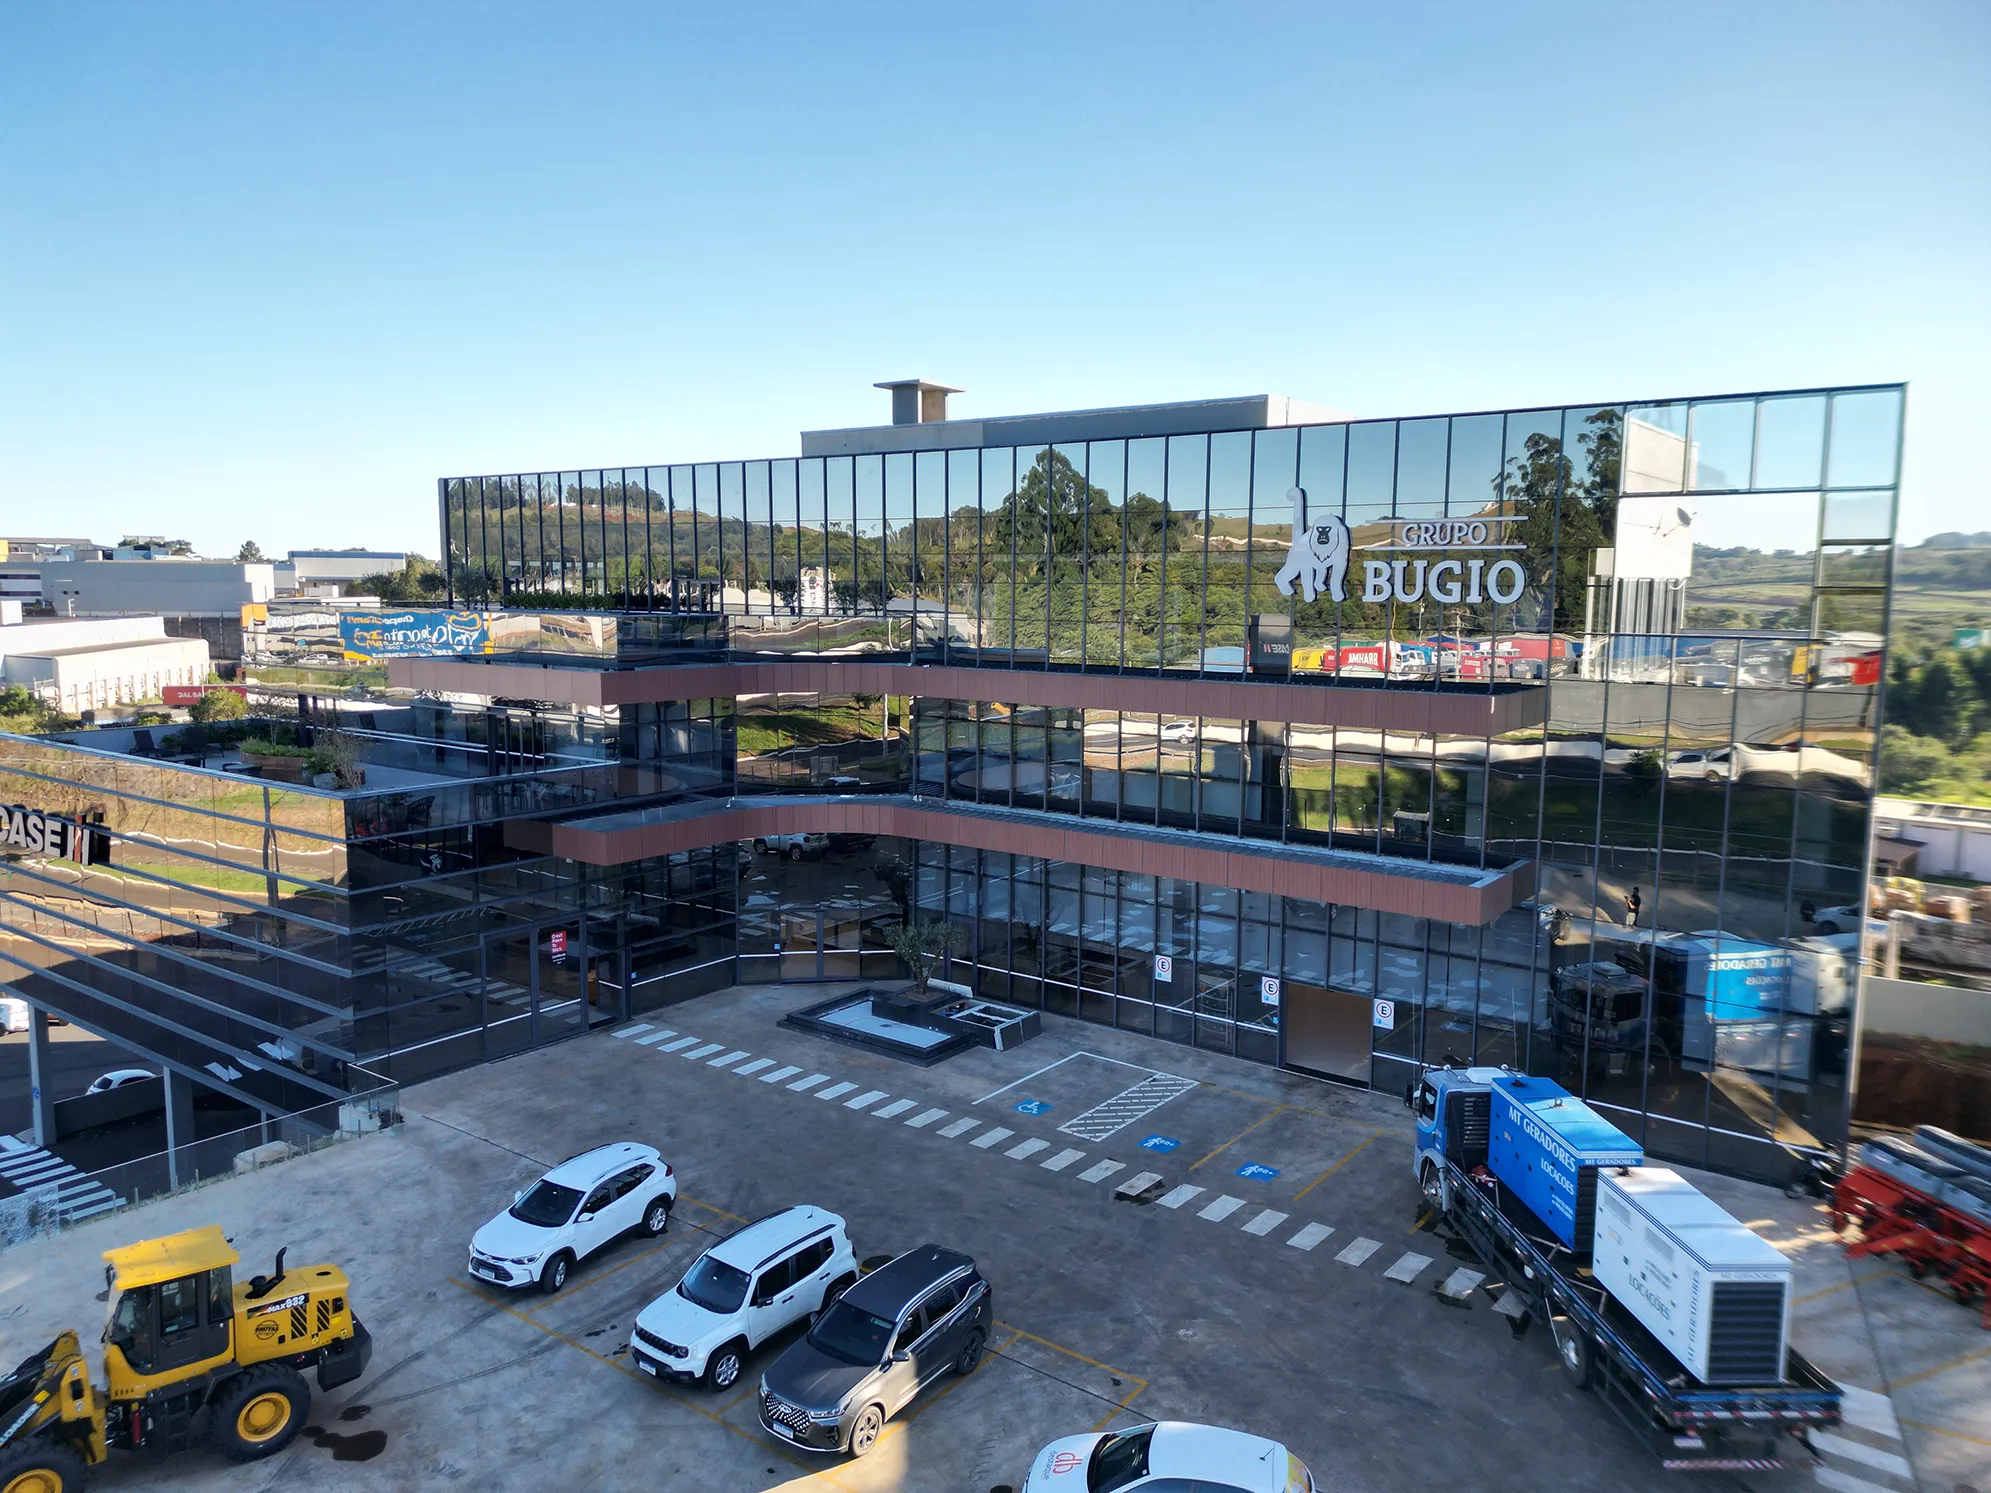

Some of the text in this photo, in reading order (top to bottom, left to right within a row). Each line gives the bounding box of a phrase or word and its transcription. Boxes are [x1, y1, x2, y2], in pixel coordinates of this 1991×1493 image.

[1402, 522, 1487, 545] GRUPO
[1362, 559, 1526, 604] BUGIO
[1161, 961, 1166, 970] E
[1268, 983, 1274, 993] E
[1381, 1005, 1387, 1015] E
[1508, 1105, 1576, 1173] MT GERADORES
